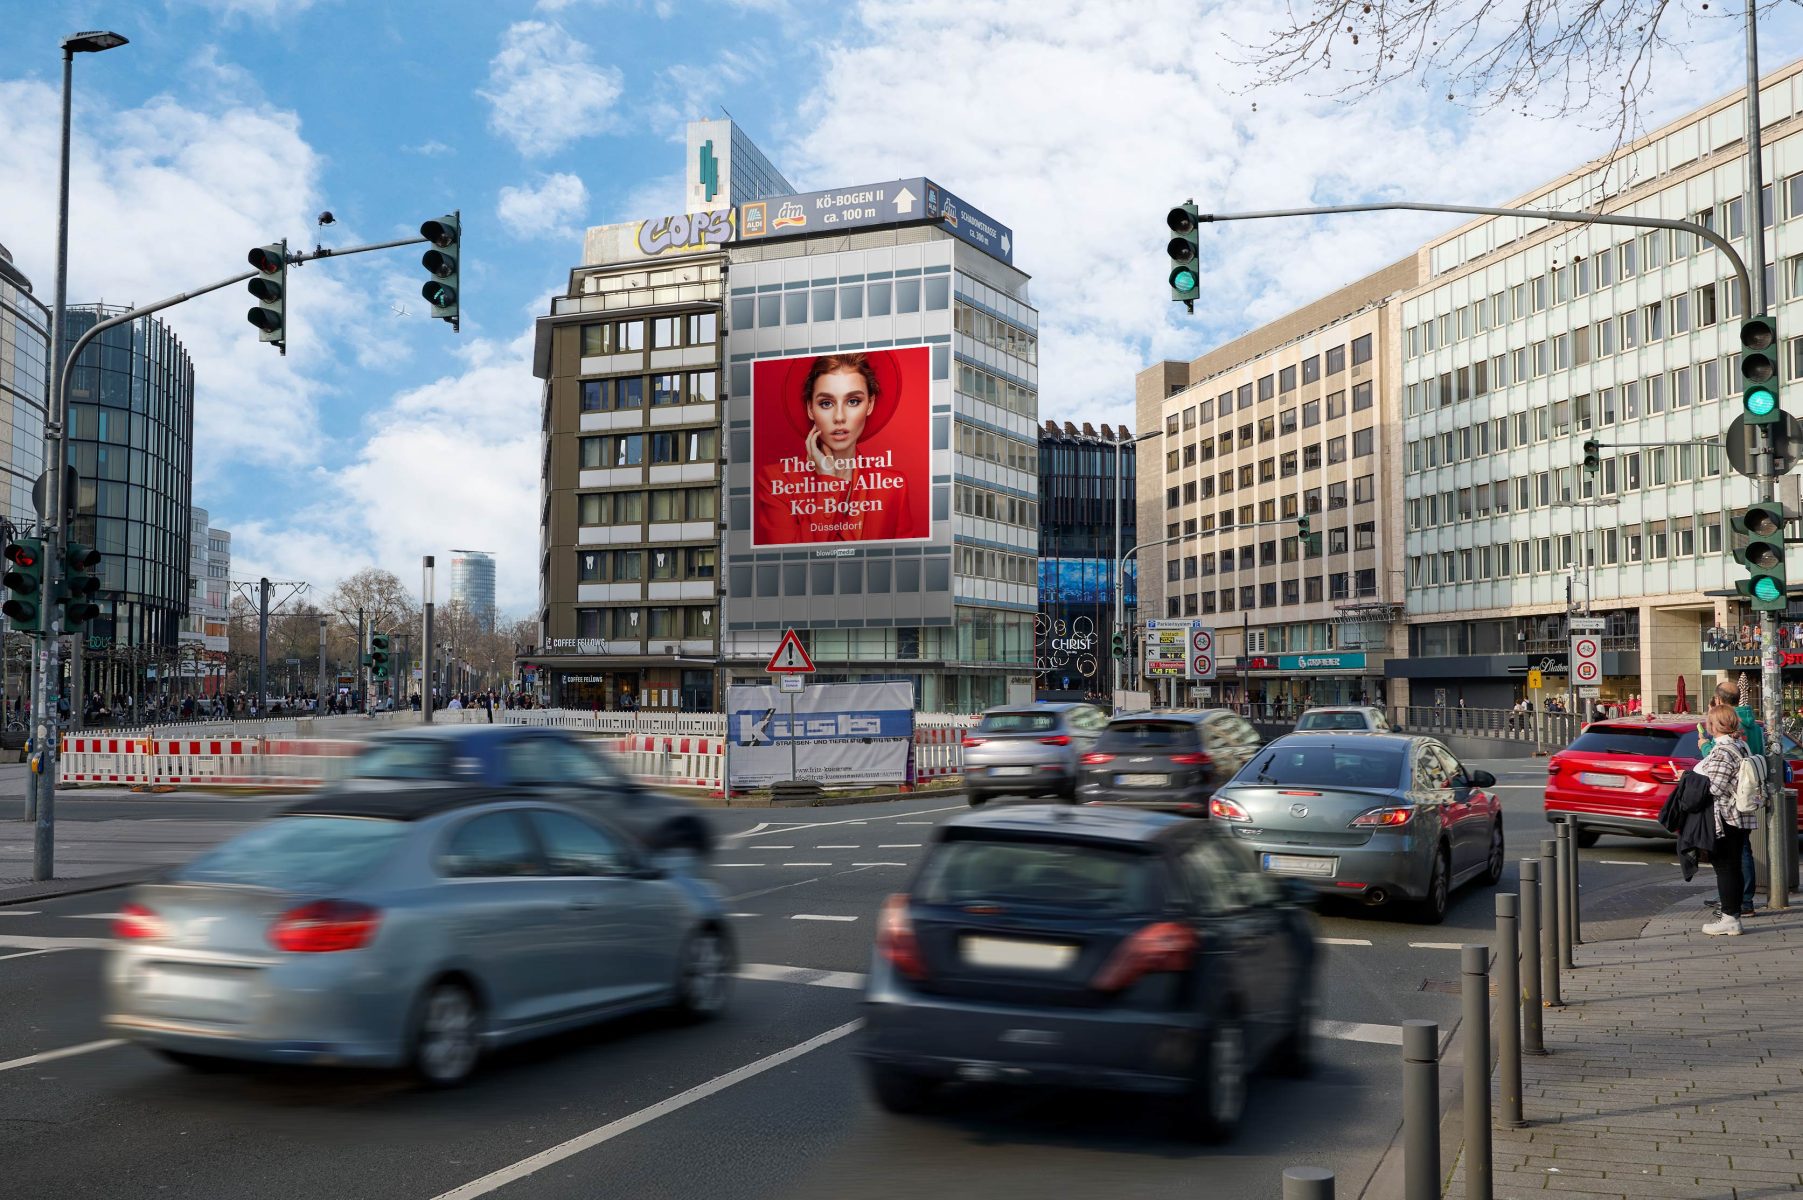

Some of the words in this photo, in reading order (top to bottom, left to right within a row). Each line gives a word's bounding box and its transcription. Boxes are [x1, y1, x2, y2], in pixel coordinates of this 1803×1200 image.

[816, 191, 873, 209] KÖ-BOGEN
[877, 190, 884, 201] II
[824, 212, 839, 223] ca.
[842, 209, 862, 221] 100
[865, 208, 876, 218] m
[747, 220, 762, 229] ALDI
[638, 209, 734, 255] COPS
[780, 456, 816, 474] The
[821, 450, 894, 471] Central
[771, 477, 849, 496] Berliner
[854, 473, 904, 491] Allee
[790, 497, 883, 517] Kö-Bogen
[810, 521, 863, 532] Düsseldorf
[553, 638, 576, 647] COFFEE
[577, 638, 606, 647] FELLOWS
[1051, 638, 1092, 650] CHRIST
[1733, 655, 1760, 665] PIZZA
[583, 675, 603, 683] FELLOWS
